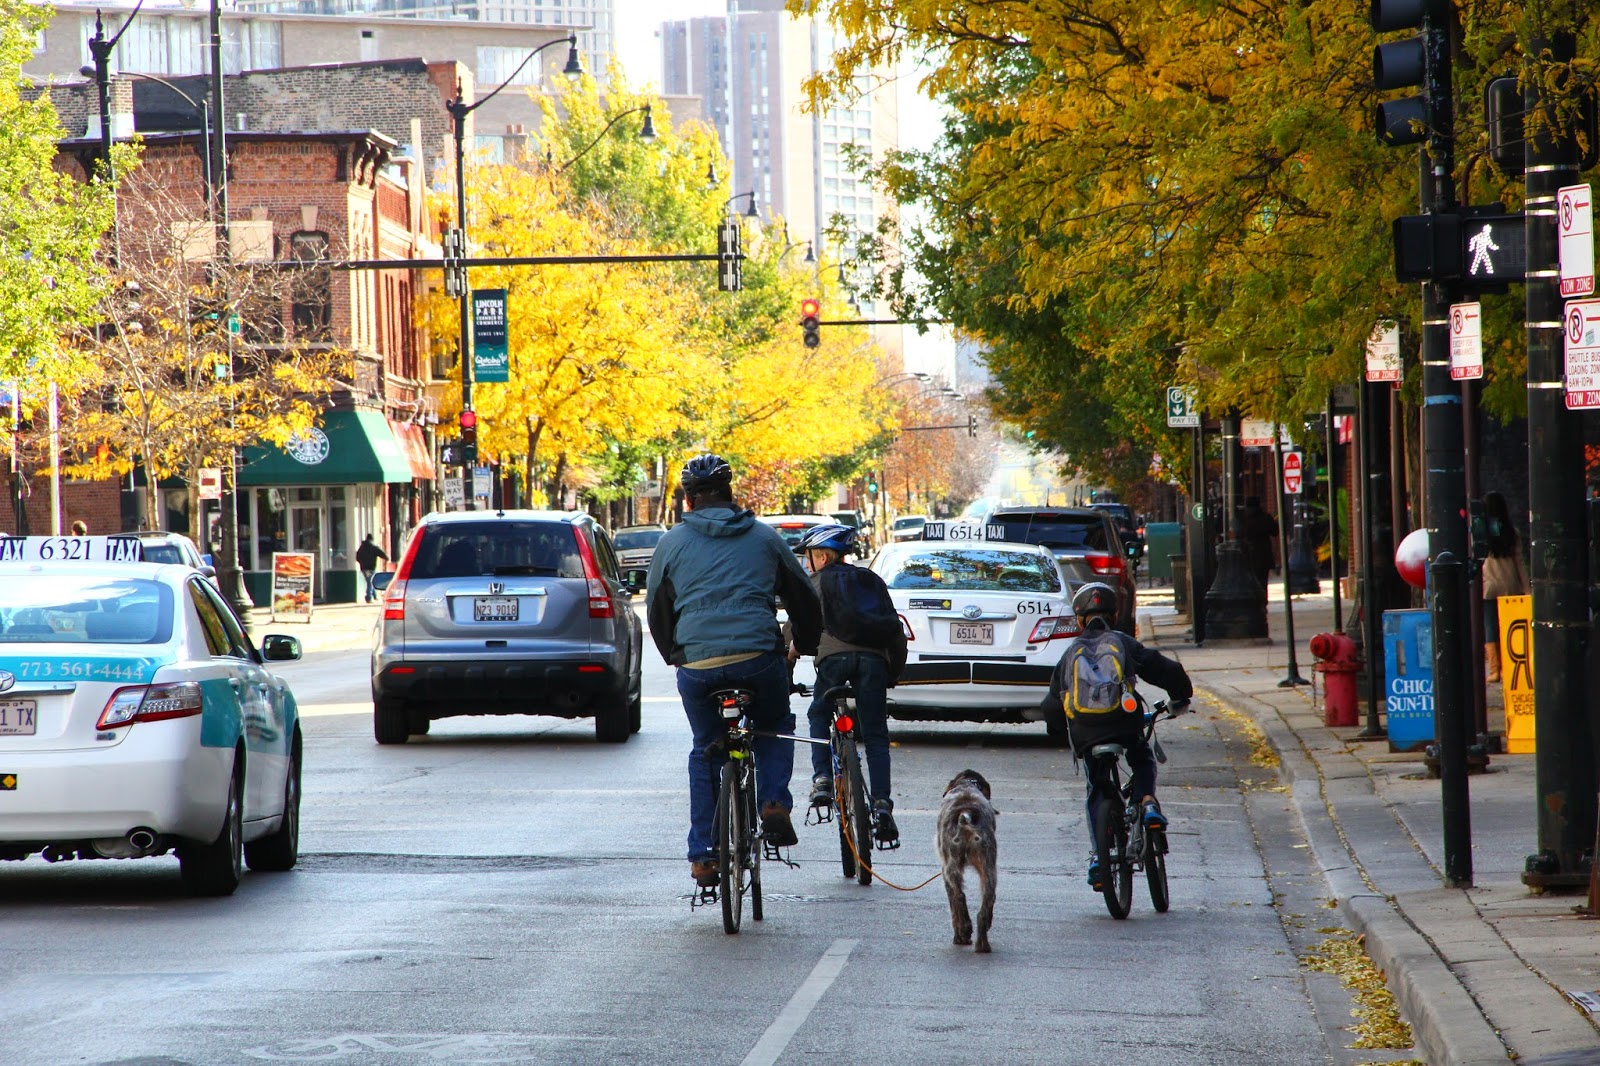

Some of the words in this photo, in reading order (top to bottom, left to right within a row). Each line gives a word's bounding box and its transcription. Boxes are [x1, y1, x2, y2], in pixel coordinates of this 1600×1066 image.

[1563, 280, 1574, 293] TOW
[1576, 277, 1591, 291] ZONE
[475, 300, 503, 308] LINCOLN
[476, 308, 503, 316] PARK
[1568, 352, 1589, 363] SHUTTLE
[1368, 371, 1380, 380] TOW
[1382, 370, 1396, 379] ZONE
[1453, 368, 1464, 377] TOW
[1466, 366, 1480, 376] ZONE
[1568, 364, 1588, 375] LOADING
[1569, 376, 1593, 387] 6AM-10PM
[1569, 392, 1584, 405] TOW
[295, 452, 324, 462] COFFEE
[926, 525, 942, 538] TAXI
[950, 525, 982, 540] 6514
[987, 525, 1005, 539] TAXI
[40, 538, 91, 560] 6321
[107, 539, 140, 561] TAXI
[476, 605, 492, 616] N23
[496, 604, 517, 615] 9018
[1017, 601, 1052, 615] 6514
[956, 628, 977, 639] 6514
[982, 628, 992, 639] TX
[20, 662, 52, 677] 773
[60, 662, 144, 680] 561-4444
[16, 708, 33, 726] TX
